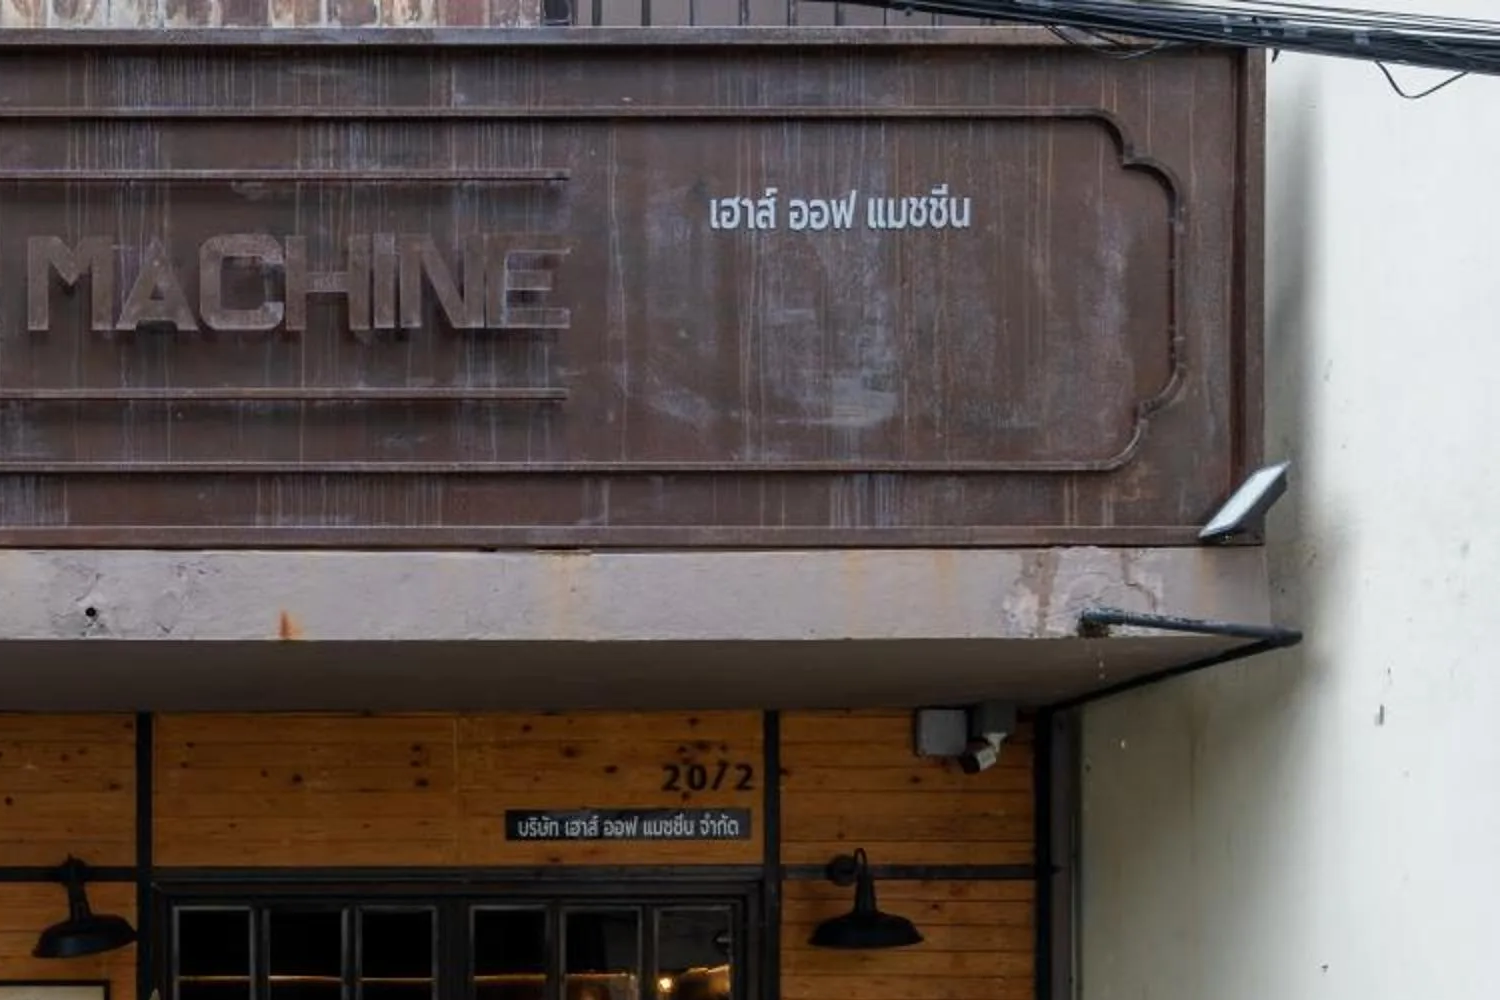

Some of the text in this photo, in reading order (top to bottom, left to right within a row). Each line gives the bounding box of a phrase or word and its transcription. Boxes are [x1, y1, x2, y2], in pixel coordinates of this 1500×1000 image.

[709, 183, 971, 230] เฮาส์ ออฟ แมชชีน
[26, 232, 572, 332] MACHINE
[661, 760, 754, 792] 20/2
[517, 812, 740, 837] บริษัท เฮาส์ ออฟ แมชชีน จำกัด
